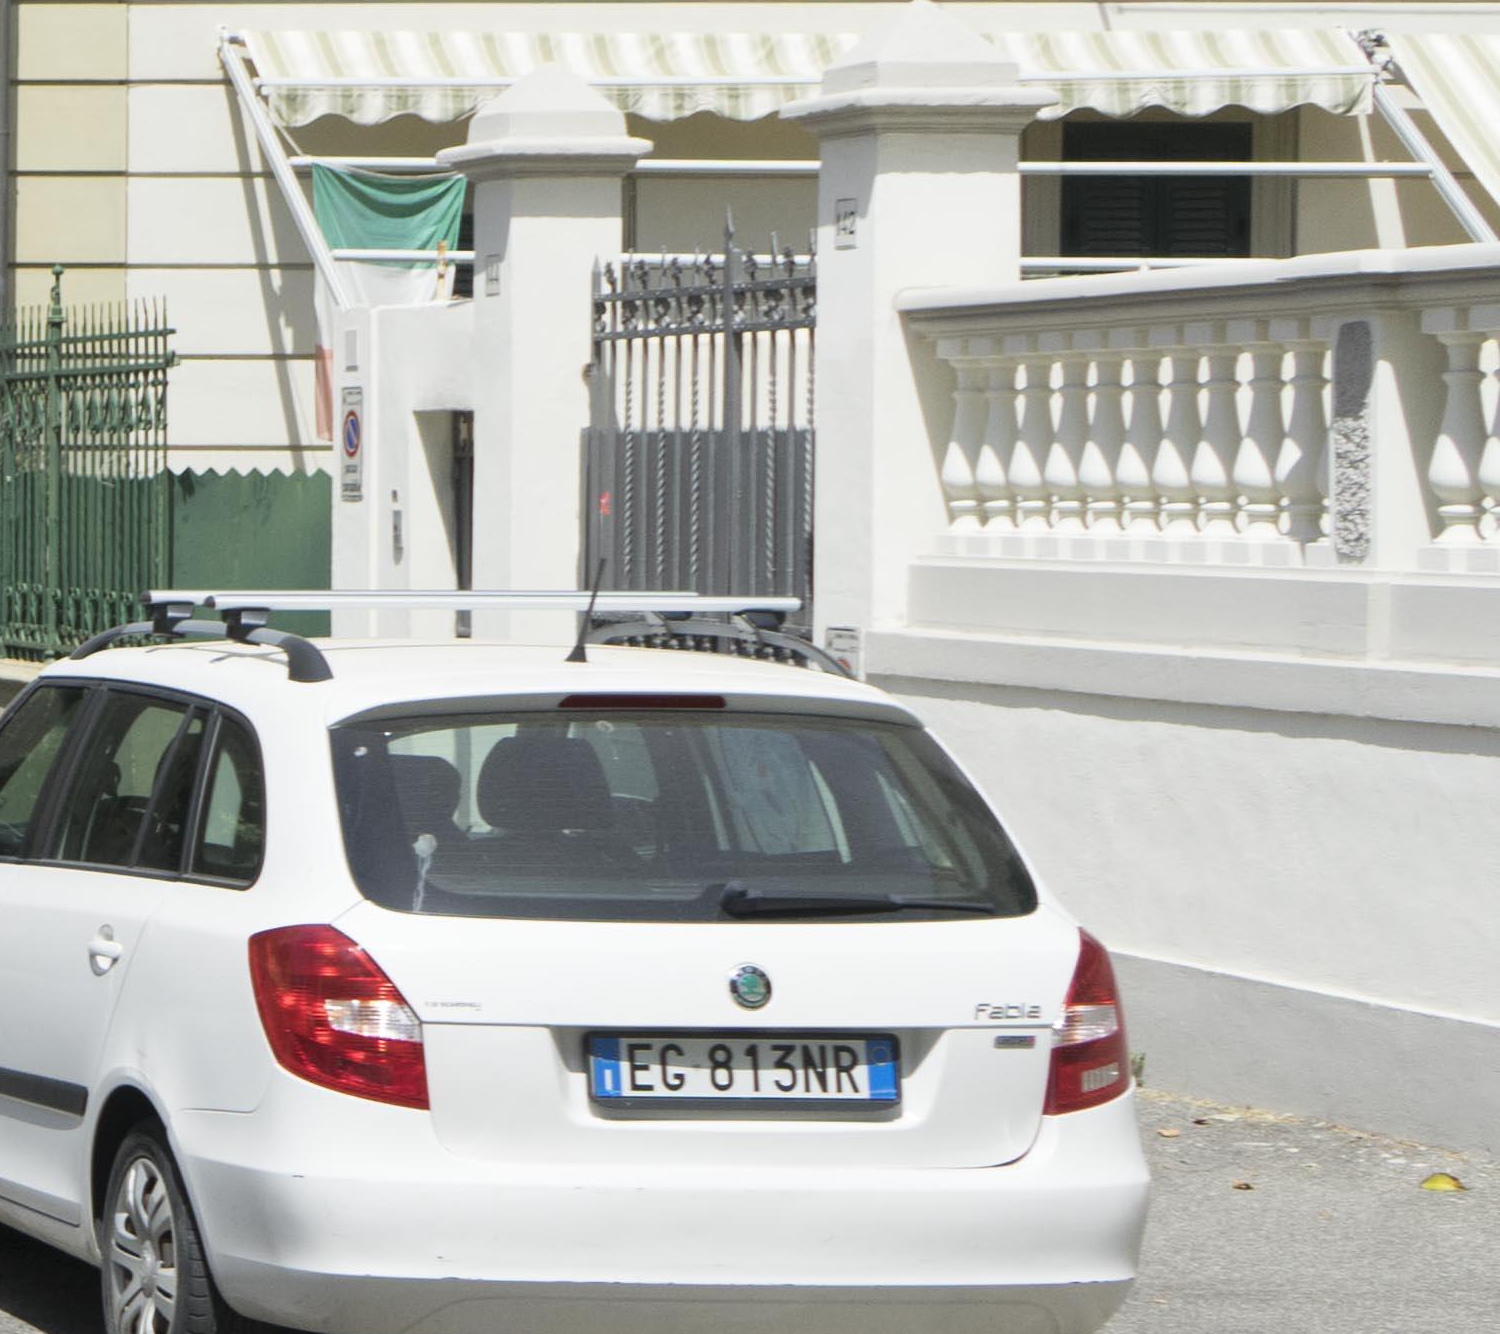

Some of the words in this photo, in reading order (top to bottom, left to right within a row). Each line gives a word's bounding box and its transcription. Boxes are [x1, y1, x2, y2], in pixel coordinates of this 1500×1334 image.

[973, 1003, 1041, 1019] Fabia
[627, 1042, 685, 1092] EG
[708, 1042, 859, 1094] 813NR
